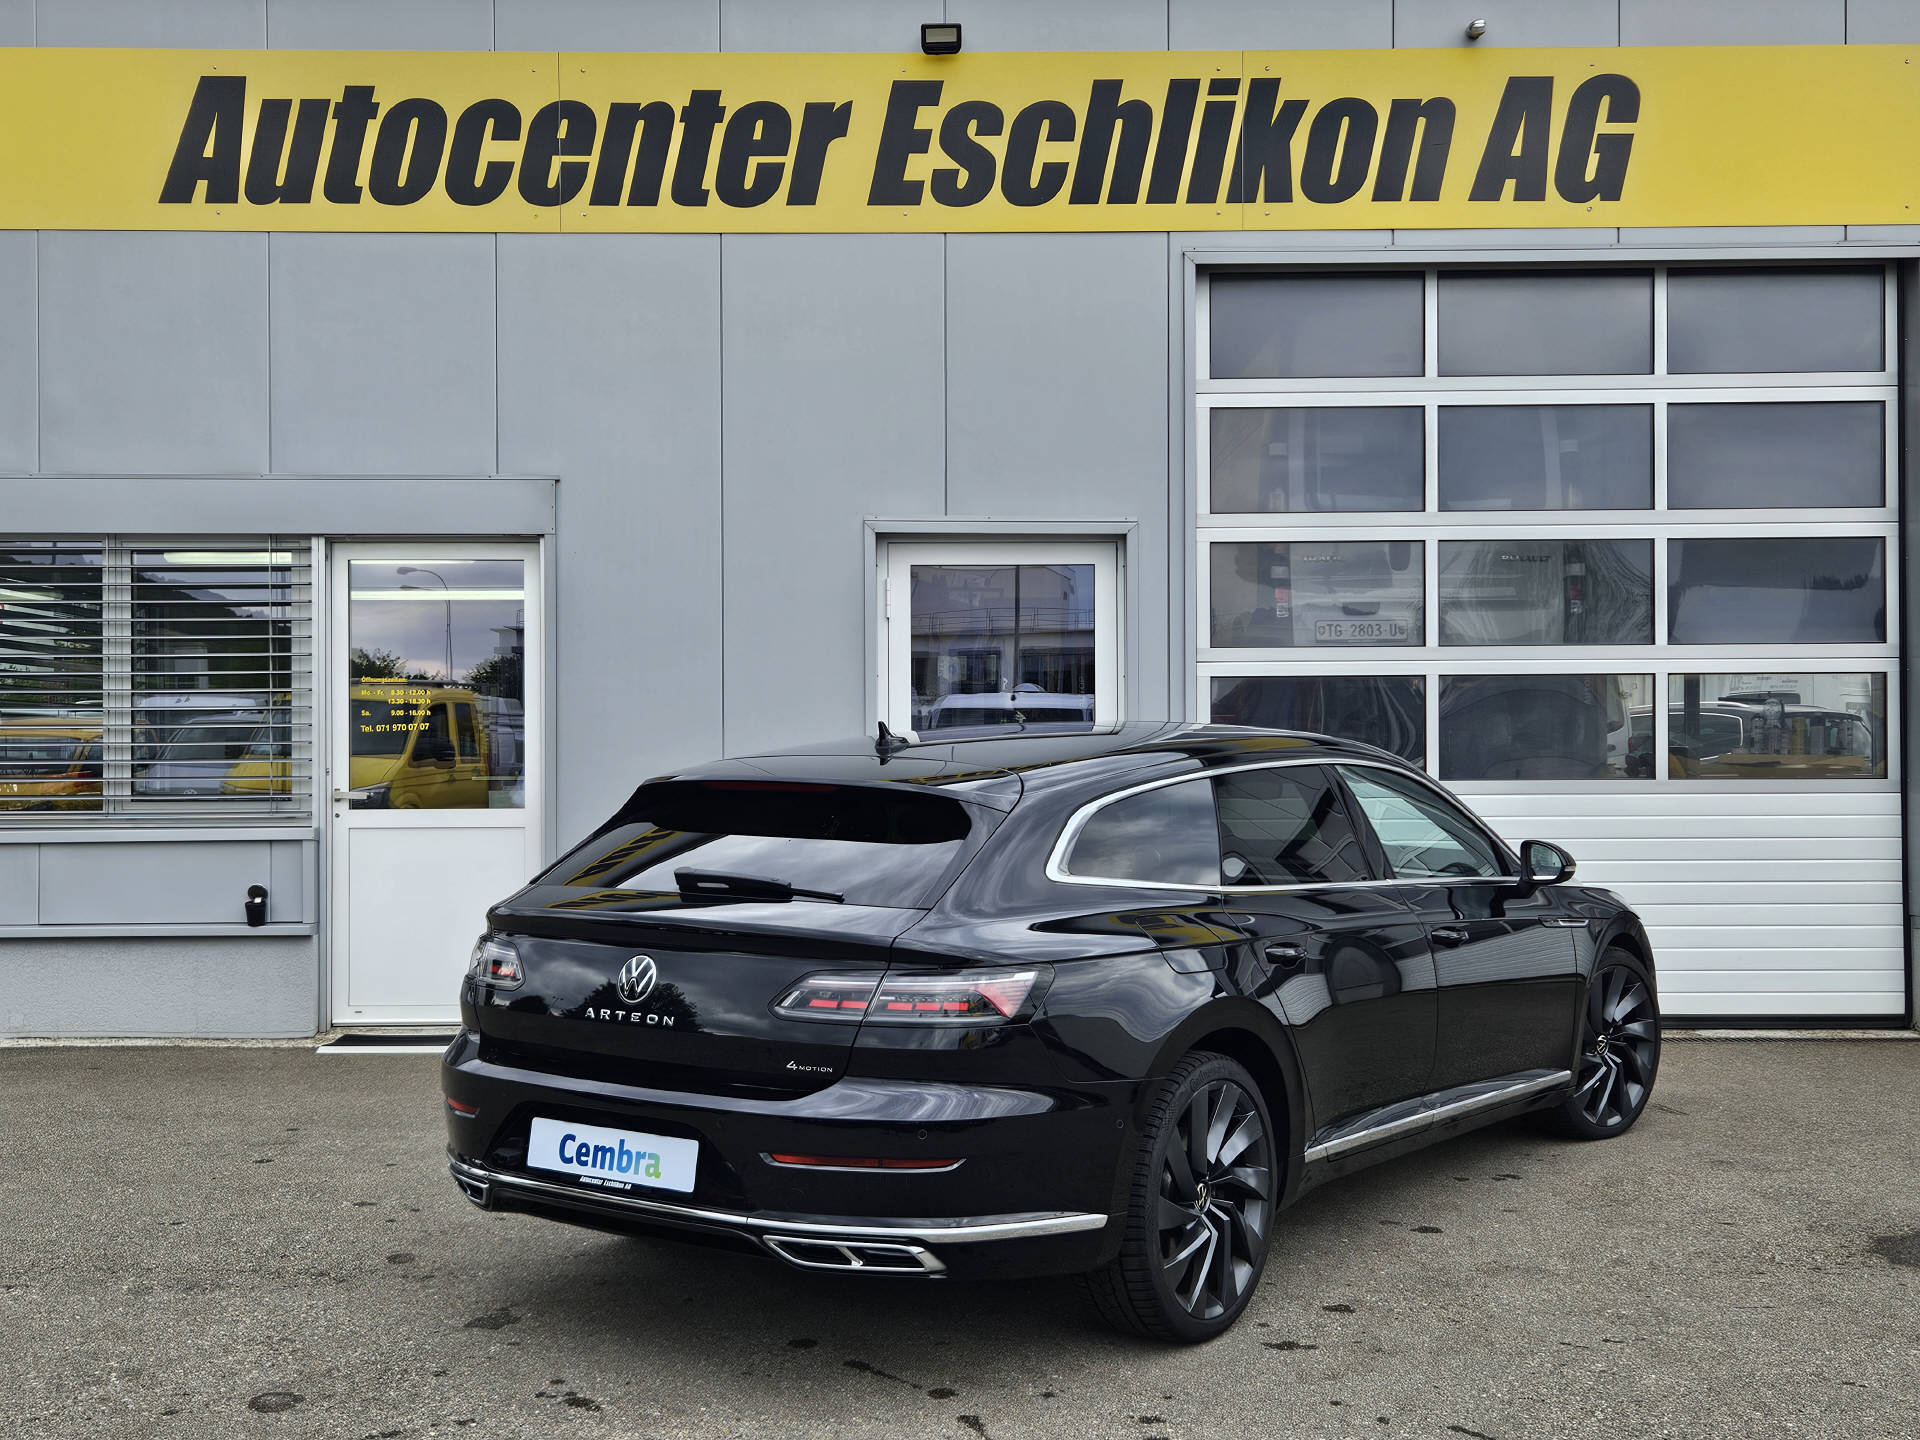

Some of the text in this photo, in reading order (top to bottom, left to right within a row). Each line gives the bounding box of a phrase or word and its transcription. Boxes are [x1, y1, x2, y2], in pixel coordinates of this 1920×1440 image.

[158, 73, 1641, 207] Autocenter Eschlikon AG
[1351, 623, 1382, 638] 2803
[360, 722, 430, 733] Tel. 071 970 07 07
[585, 1007, 675, 1027] ARTEON
[558, 1133, 662, 1179] Cembra
